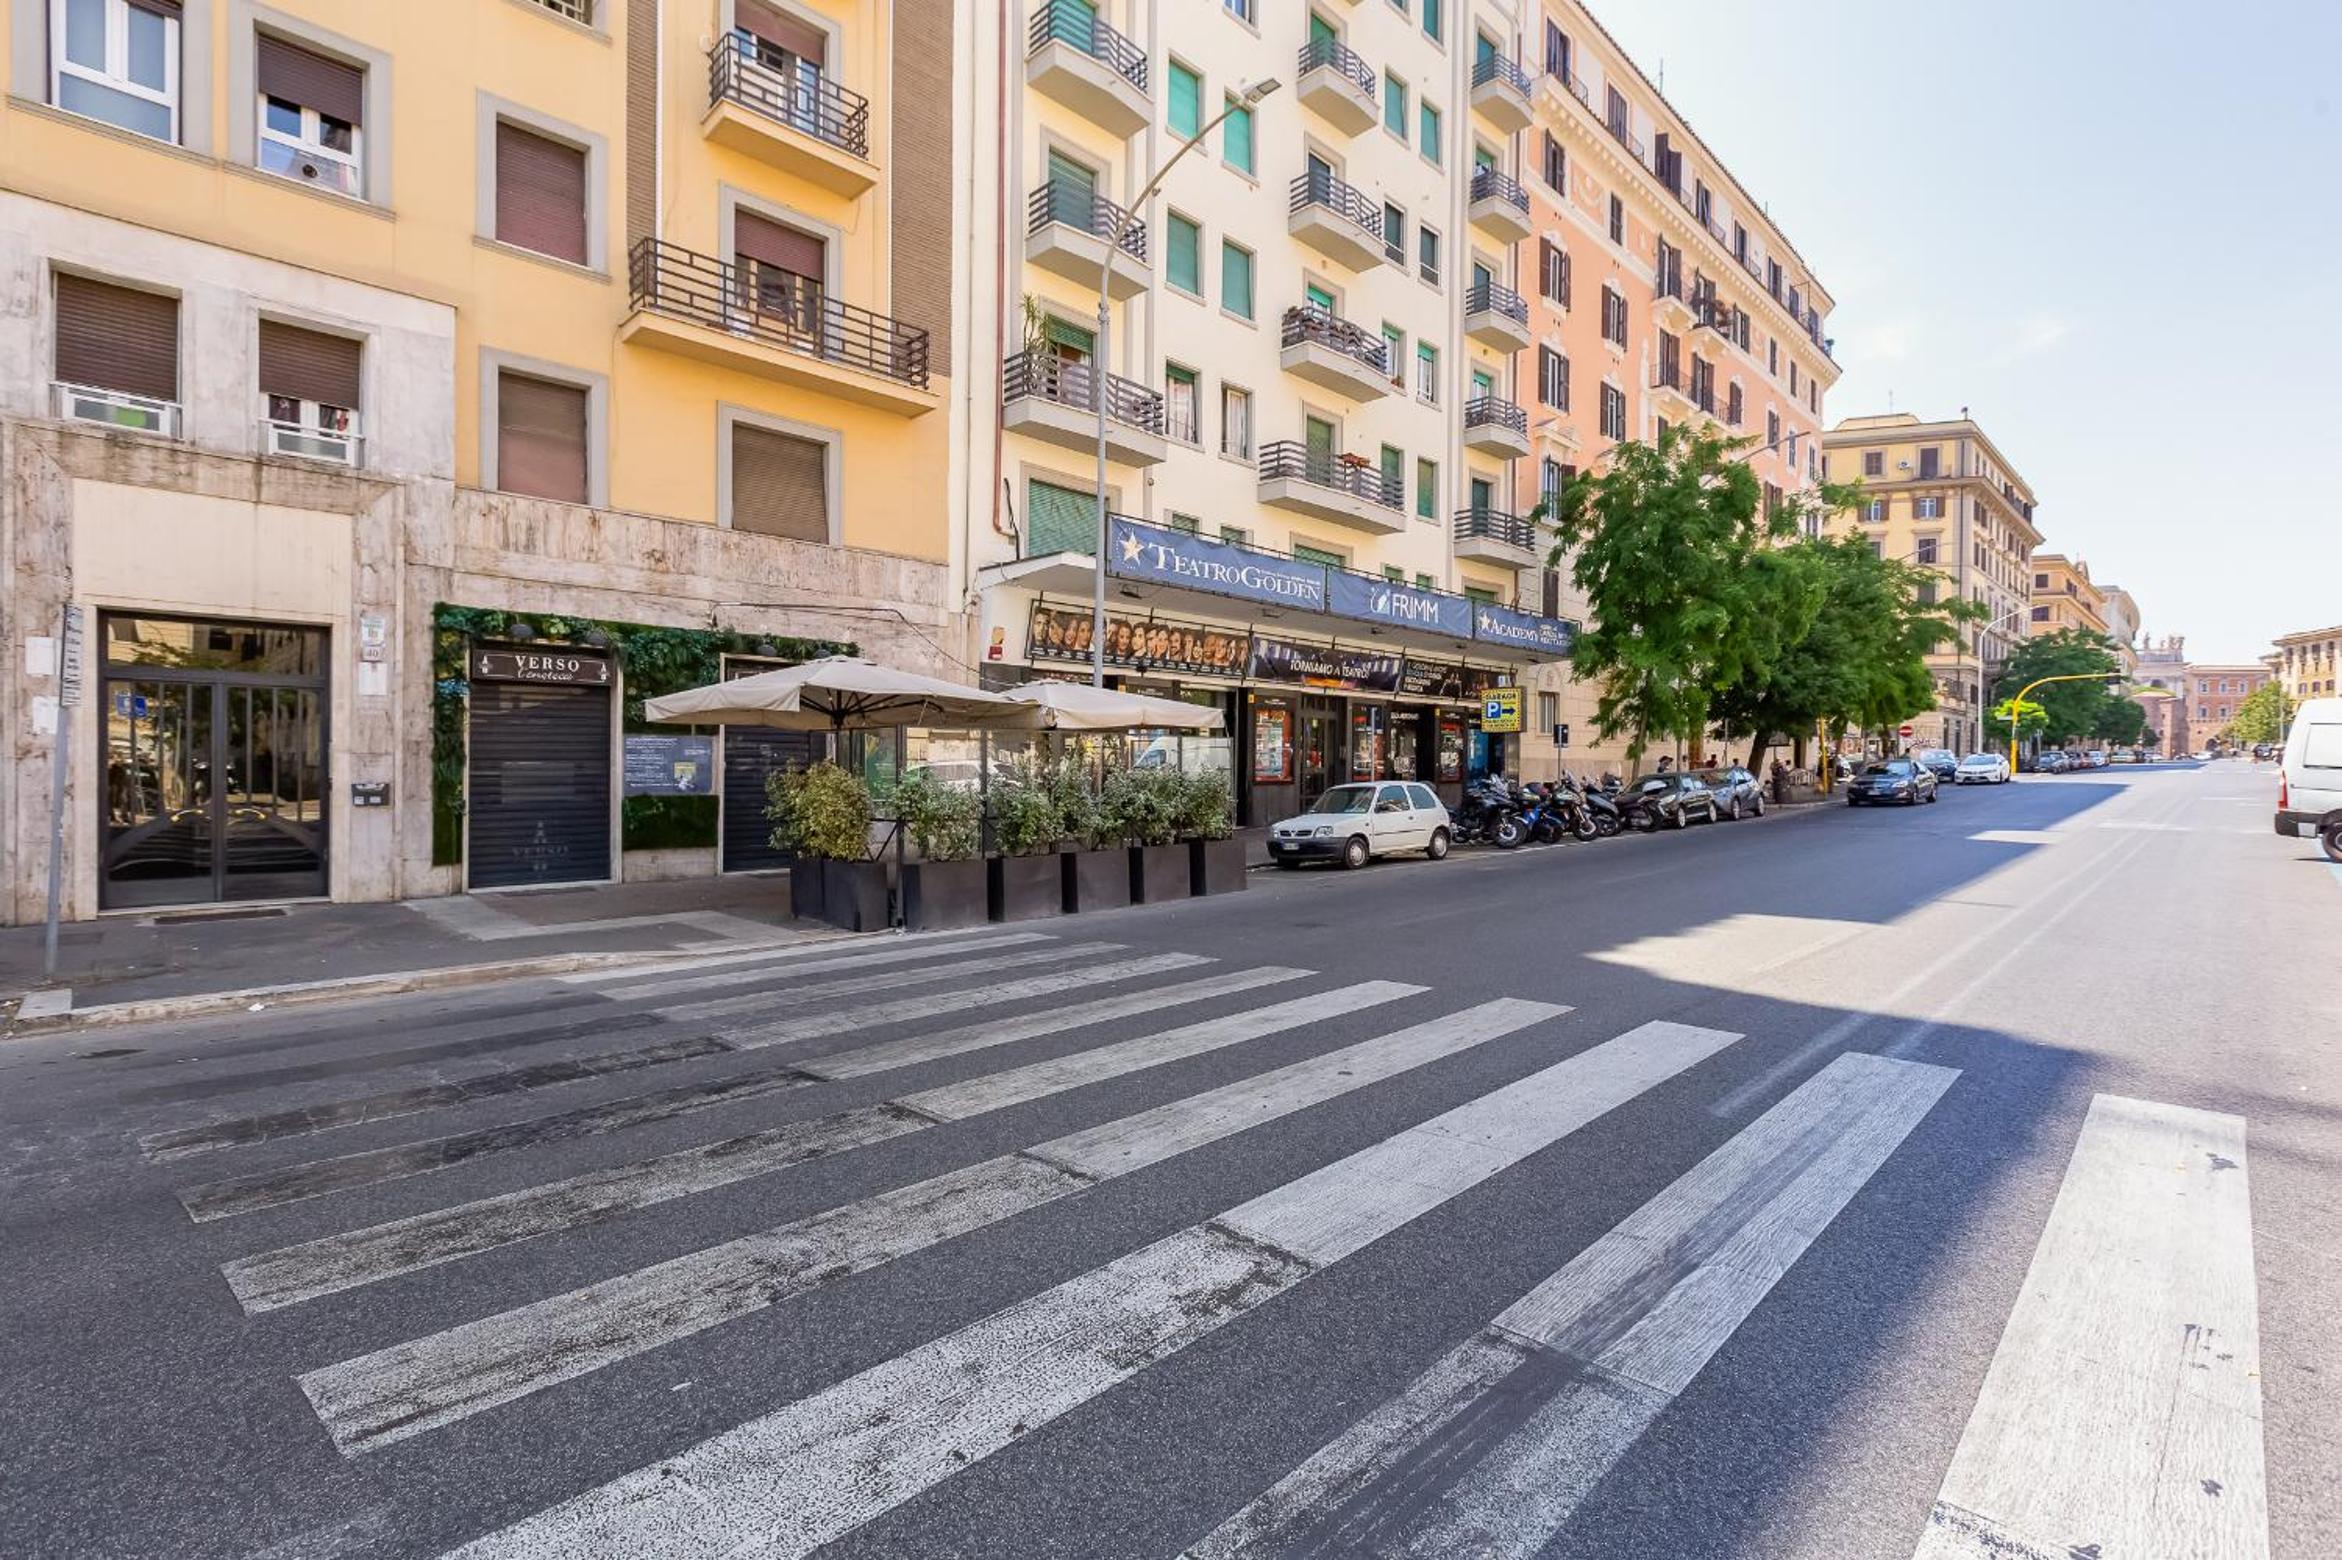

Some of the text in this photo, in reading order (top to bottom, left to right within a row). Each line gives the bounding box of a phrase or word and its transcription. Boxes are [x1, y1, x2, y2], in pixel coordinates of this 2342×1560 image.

[1391, 593, 1439, 624] FRIMM
[515, 655, 580, 672] VERSO
[1487, 702, 1499, 717] P
